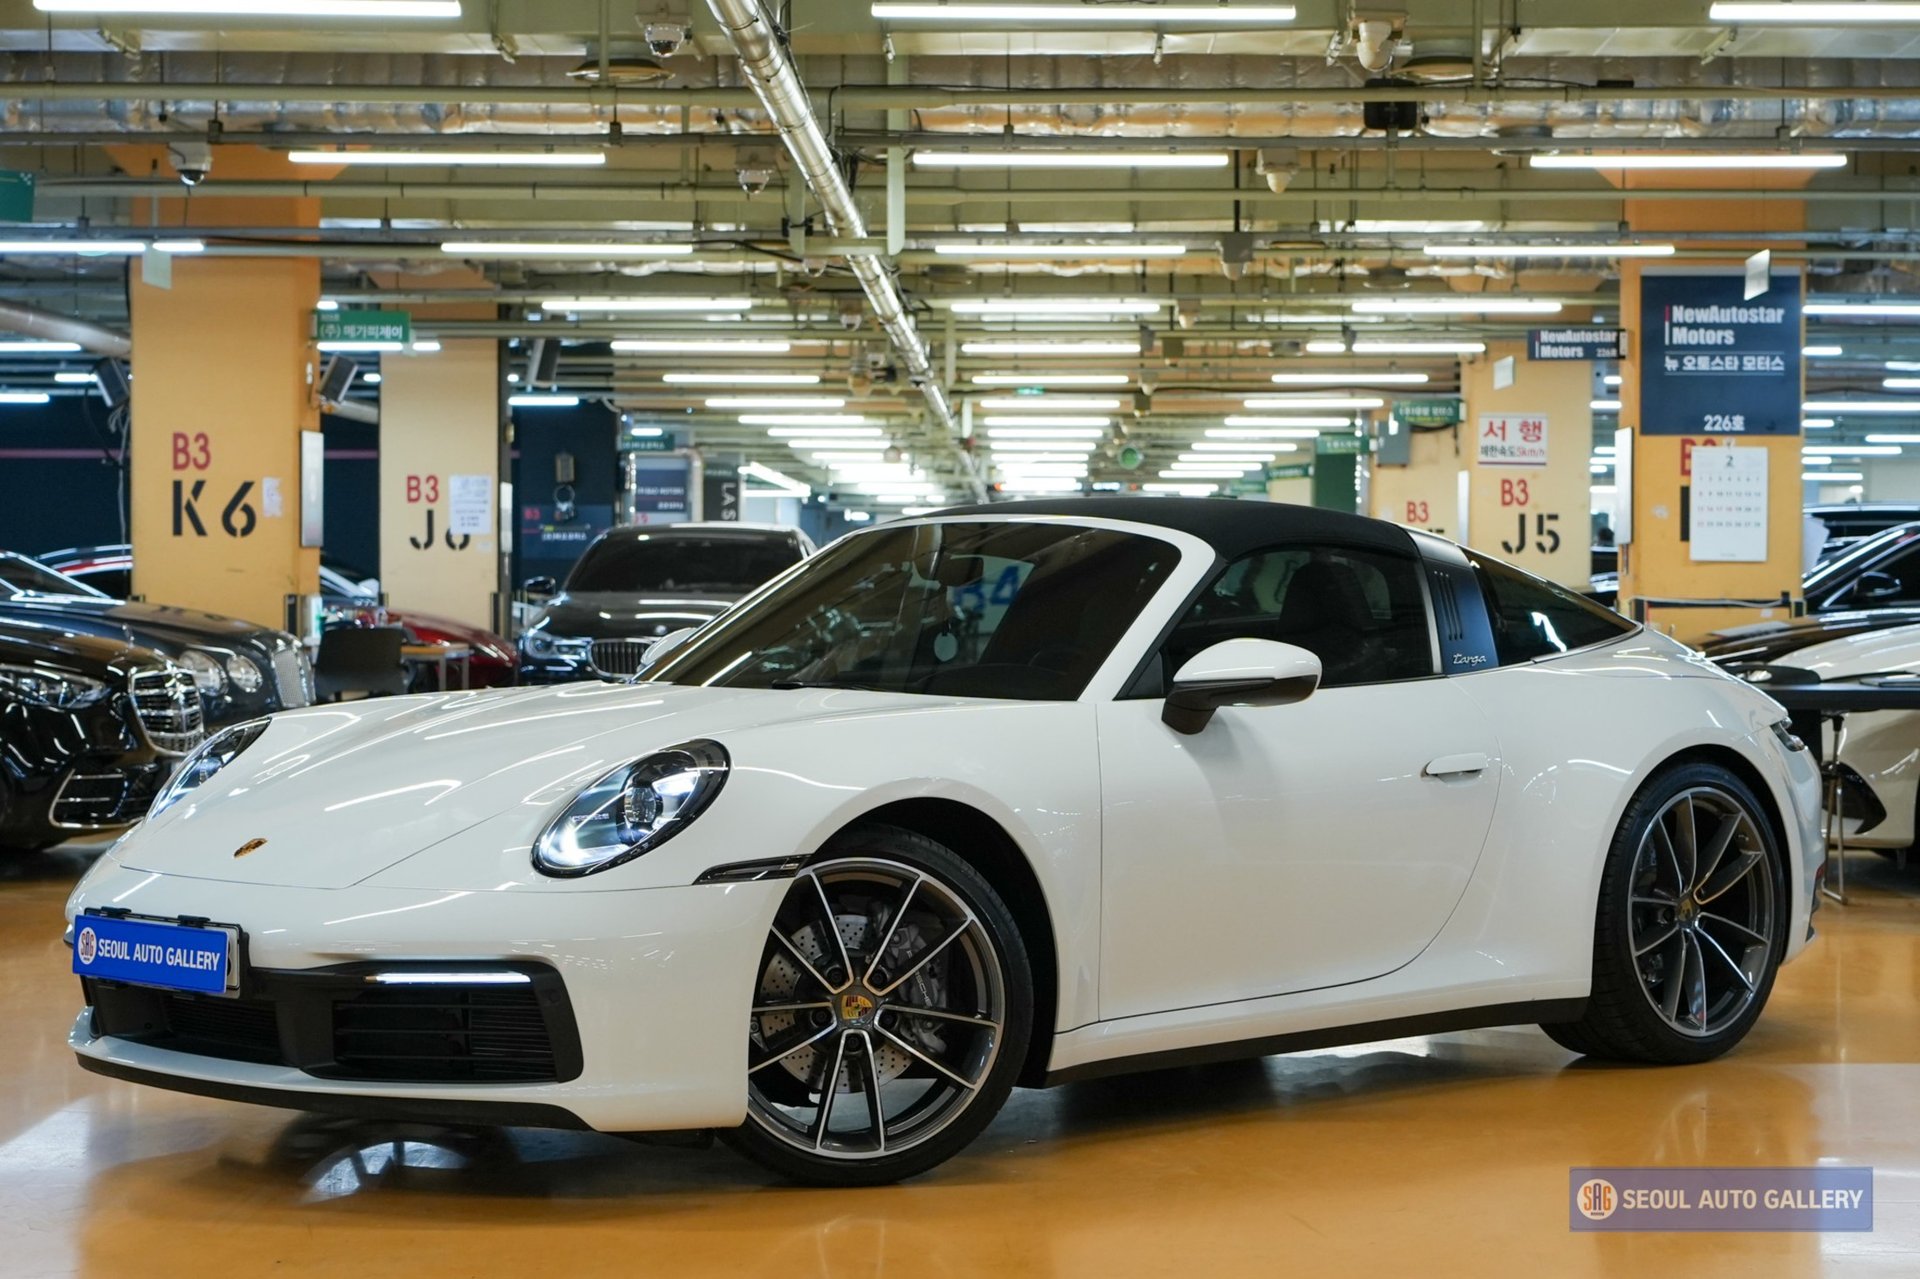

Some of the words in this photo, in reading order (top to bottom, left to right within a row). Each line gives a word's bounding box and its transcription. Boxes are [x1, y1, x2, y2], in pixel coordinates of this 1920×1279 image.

[1672, 305, 1785, 323] NewAutostar
[1540, 329, 1618, 343] NewAutostar
[1672, 327, 1735, 345] Motors
[1540, 345, 1584, 358] Motors
[1664, 355, 1680, 372] 뉴
[1742, 355, 1785, 372] 모터스
[1703, 415, 1746, 432] 226호
[172, 432, 211, 471] B3
[406, 475, 439, 503] B3
[1501, 479, 1529, 507] B3
[1406, 501, 1429, 523] B3
[1501, 513, 1560, 553] J5
[98, 938, 130, 960] SEOUL
[133, 943, 163, 965] AUTO
[166, 947, 221, 971] GALLERY
